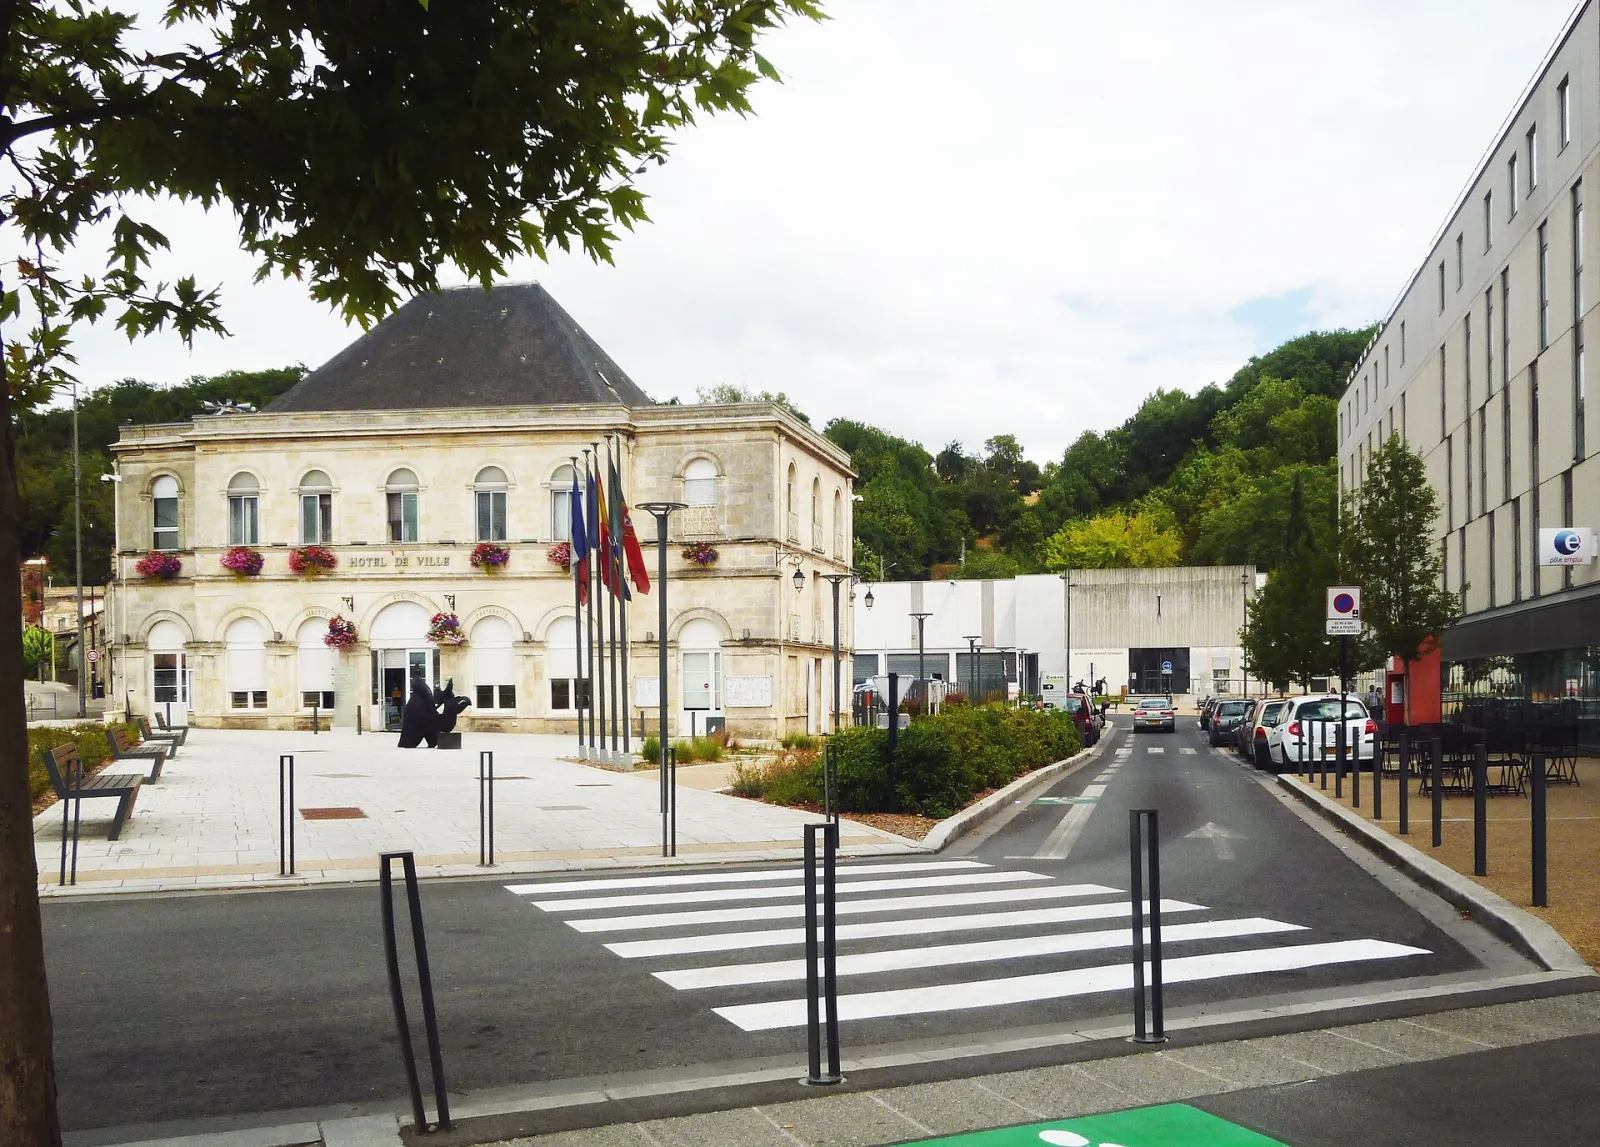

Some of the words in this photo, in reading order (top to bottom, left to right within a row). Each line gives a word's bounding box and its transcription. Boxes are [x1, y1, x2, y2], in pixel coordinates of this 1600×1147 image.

[349, 557, 387, 567] HOTEL
[394, 557, 409, 567] DE
[416, 556, 450, 567] VILLE
